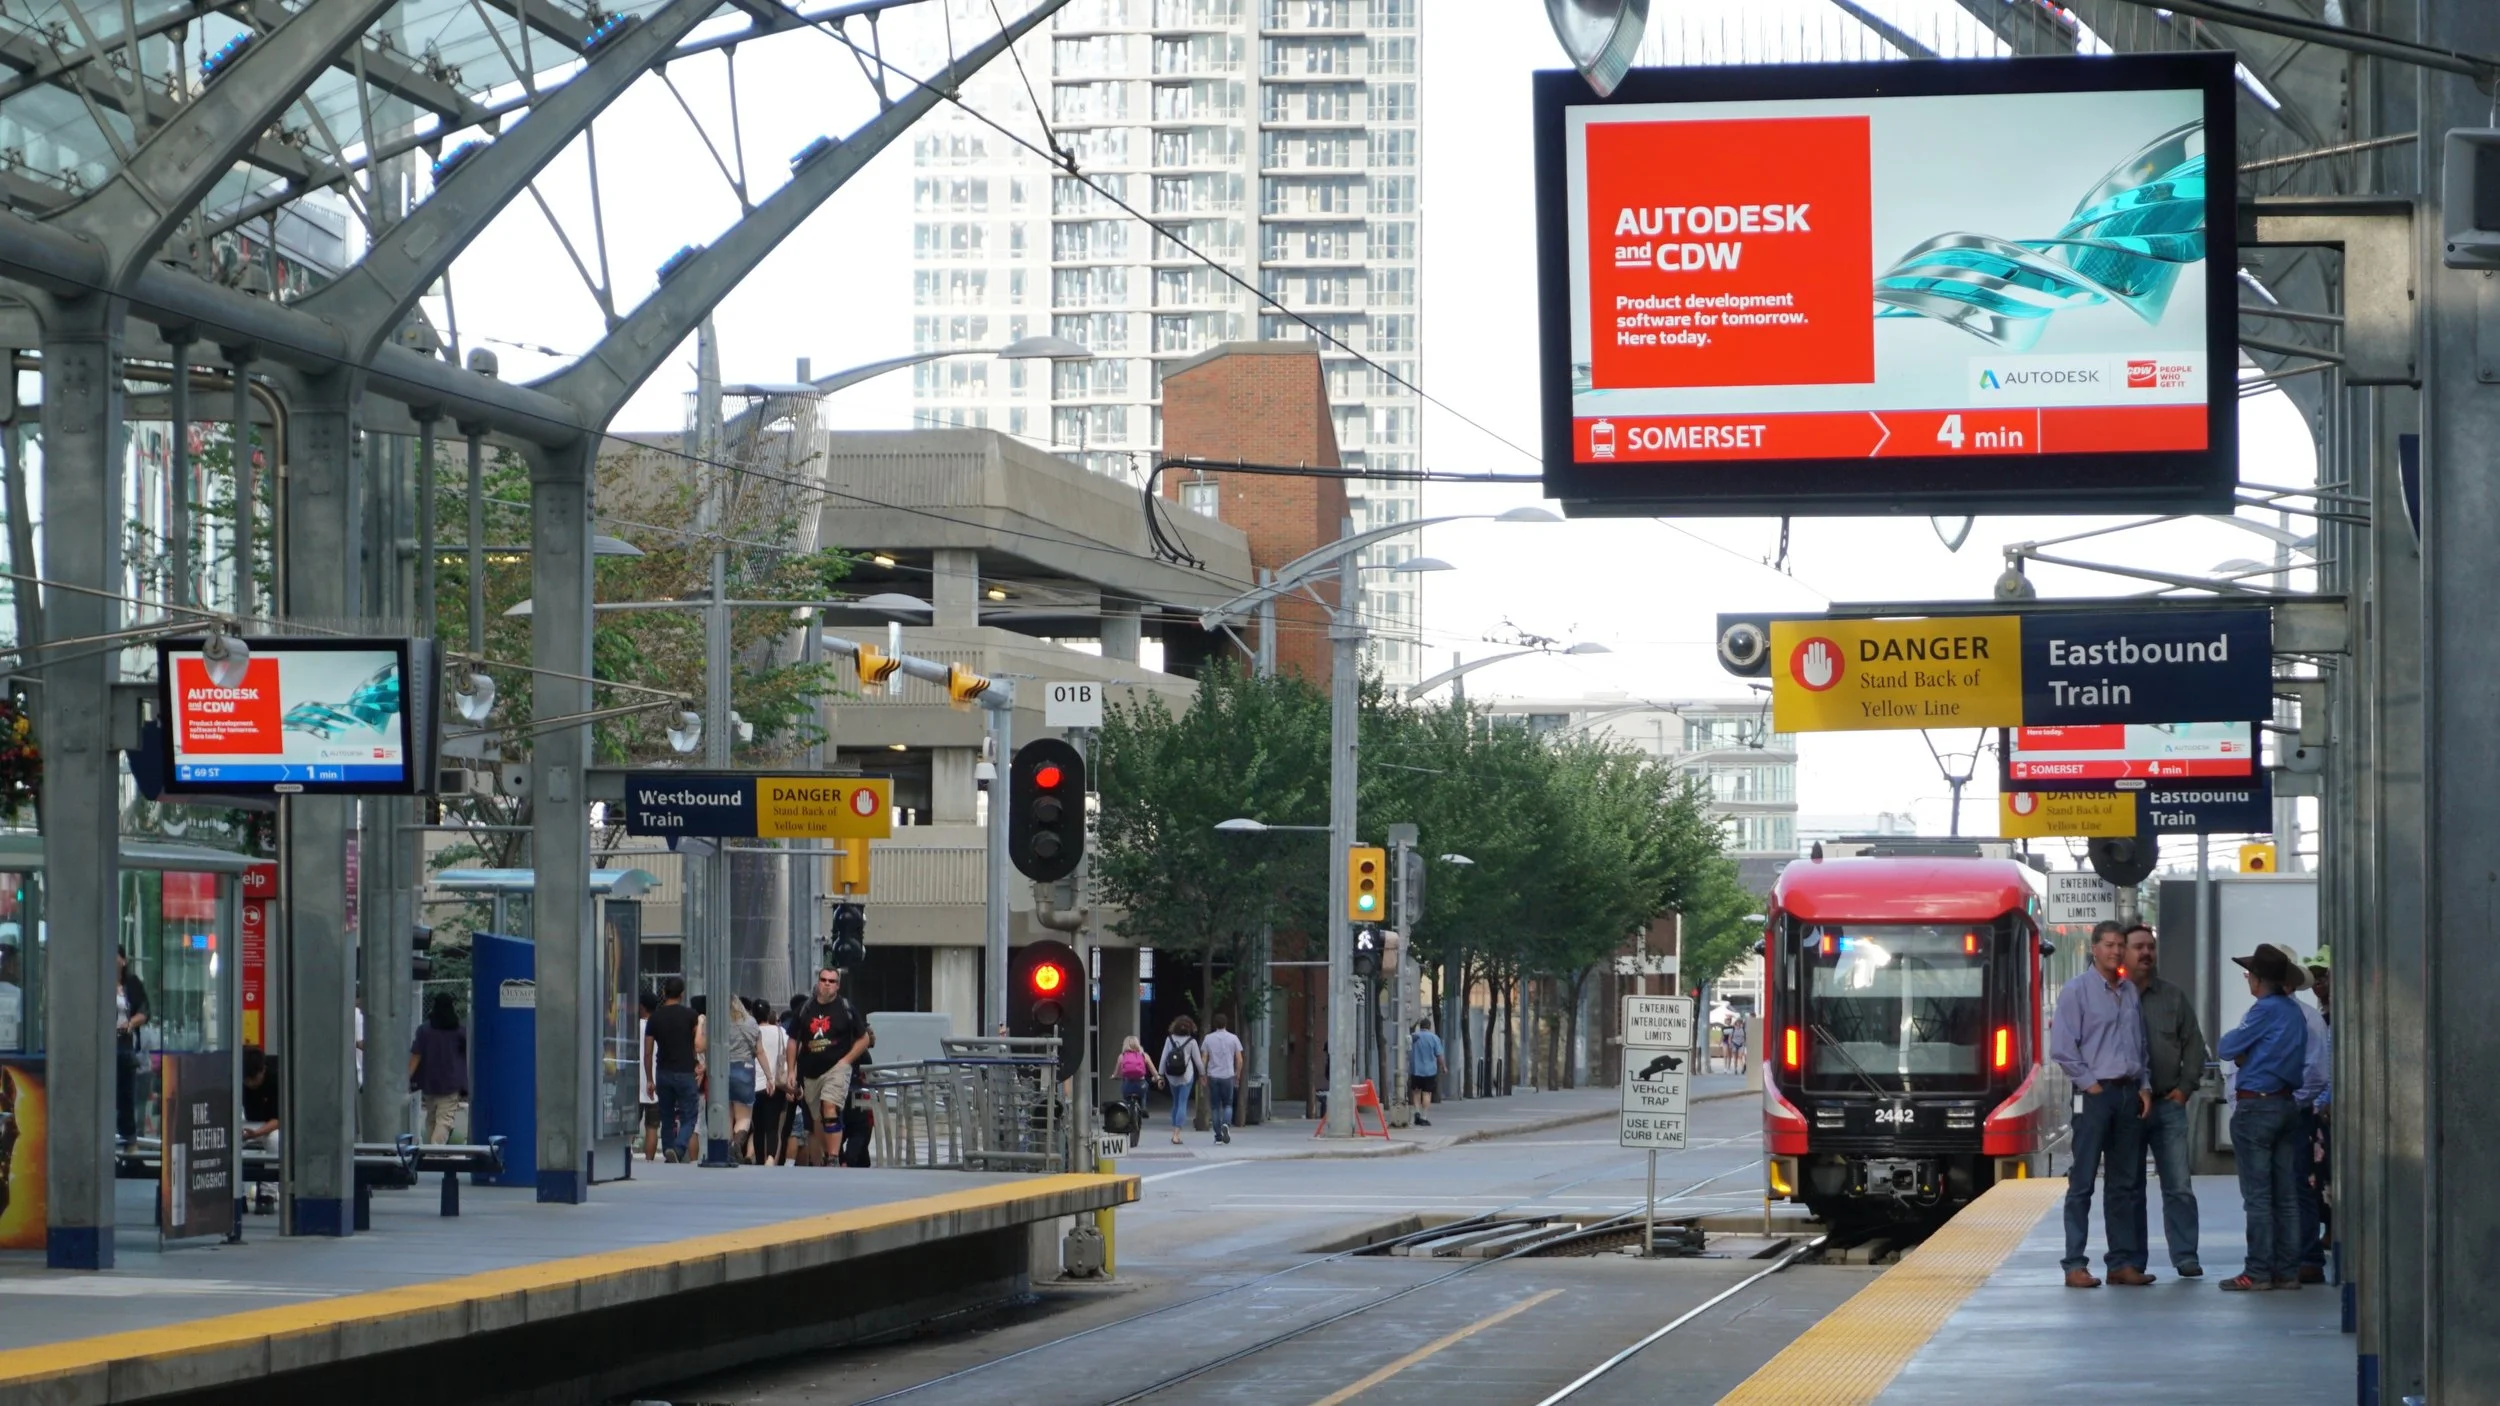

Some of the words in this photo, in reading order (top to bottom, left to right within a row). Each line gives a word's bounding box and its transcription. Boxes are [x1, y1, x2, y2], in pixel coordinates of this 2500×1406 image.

[1615, 204, 1811, 236] AUTODESK
[1615, 242, 1651, 267] and
[1656, 242, 1741, 271] CDW
[1616, 294, 1681, 310] Product
[1685, 293, 1793, 310] development
[1617, 312, 1691, 328] software
[1694, 311, 1718, 326] for
[1721, 311, 1809, 326] tomorrow.
[1617, 331, 1657, 346] Here
[1660, 330, 1711, 347] today.
[2005, 370, 2099, 384] AUTODESK
[1628, 425, 1765, 450] SOMERSET
[1937, 414, 1964, 448] 4
[1975, 426, 2023, 448] min
[1860, 636, 1989, 662] DANGER
[2049, 634, 2228, 666] Eastbound
[1860, 669, 1909, 688] Stand
[1914, 669, 1957, 687] Back
[1962, 668, 1980, 687] of
[188, 688, 258, 699] AUTODESK
[1054, 686, 1091, 703] 01B
[2049, 679, 2131, 706] Train
[203, 702, 234, 712] CDW
[1860, 699, 1918, 717] Yellow
[1923, 698, 1960, 716] Line
[194, 768, 206, 777] 69
[208, 768, 220, 777] ST
[306, 767, 315, 779] 1
[320, 769, 337, 779] min
[2031, 765, 2084, 774] SOMERSET
[2148, 761, 2160, 774] 4
[2162, 765, 2182, 775] min
[639, 789, 742, 806] Westbound
[773, 788, 841, 802] DANGER
[2150, 792, 2249, 804] Eastbound
[773, 806, 799, 817] Stand
[802, 806, 824, 817] Back
[827, 805, 837, 816] of
[2046, 806, 2074, 816] Stand
[2077, 805, 2100, 815] Back
[2103, 805, 2112, 815] of
[640, 812, 683, 827] Train
[2047, 821, 2077, 830] Yellow
[2080, 820, 2101, 830] Line
[2150, 811, 2196, 825] Train
[774, 821, 801, 832] Yellow
[804, 821, 827, 832] Line
[243, 871, 265, 887] elp
[2060, 878, 2103, 888] ENTERING
[2052, 893, 2112, 902] INTERLOCKING
[2067, 907, 2096, 917] LIMITS
[1639, 1003, 1680, 1014] ENTERING
[1631, 1018, 1686, 1028] INTERLOCKING
[1645, 1030, 1672, 1041] LIMITS
[1632, 1084, 1679, 1094] VEHICLE
[1641, 1096, 1669, 1106] TRAP
[1875, 1109, 1914, 1123] 2442
[1627, 1119, 1649, 1129] USE
[1654, 1120, 1680, 1129] LEFT
[1624, 1130, 1651, 1140] CURB
[1656, 1131, 1683, 1142] LANE
[1102, 1139, 1124, 1155] HW
[192, 1172, 227, 1190] LONGSHOT
